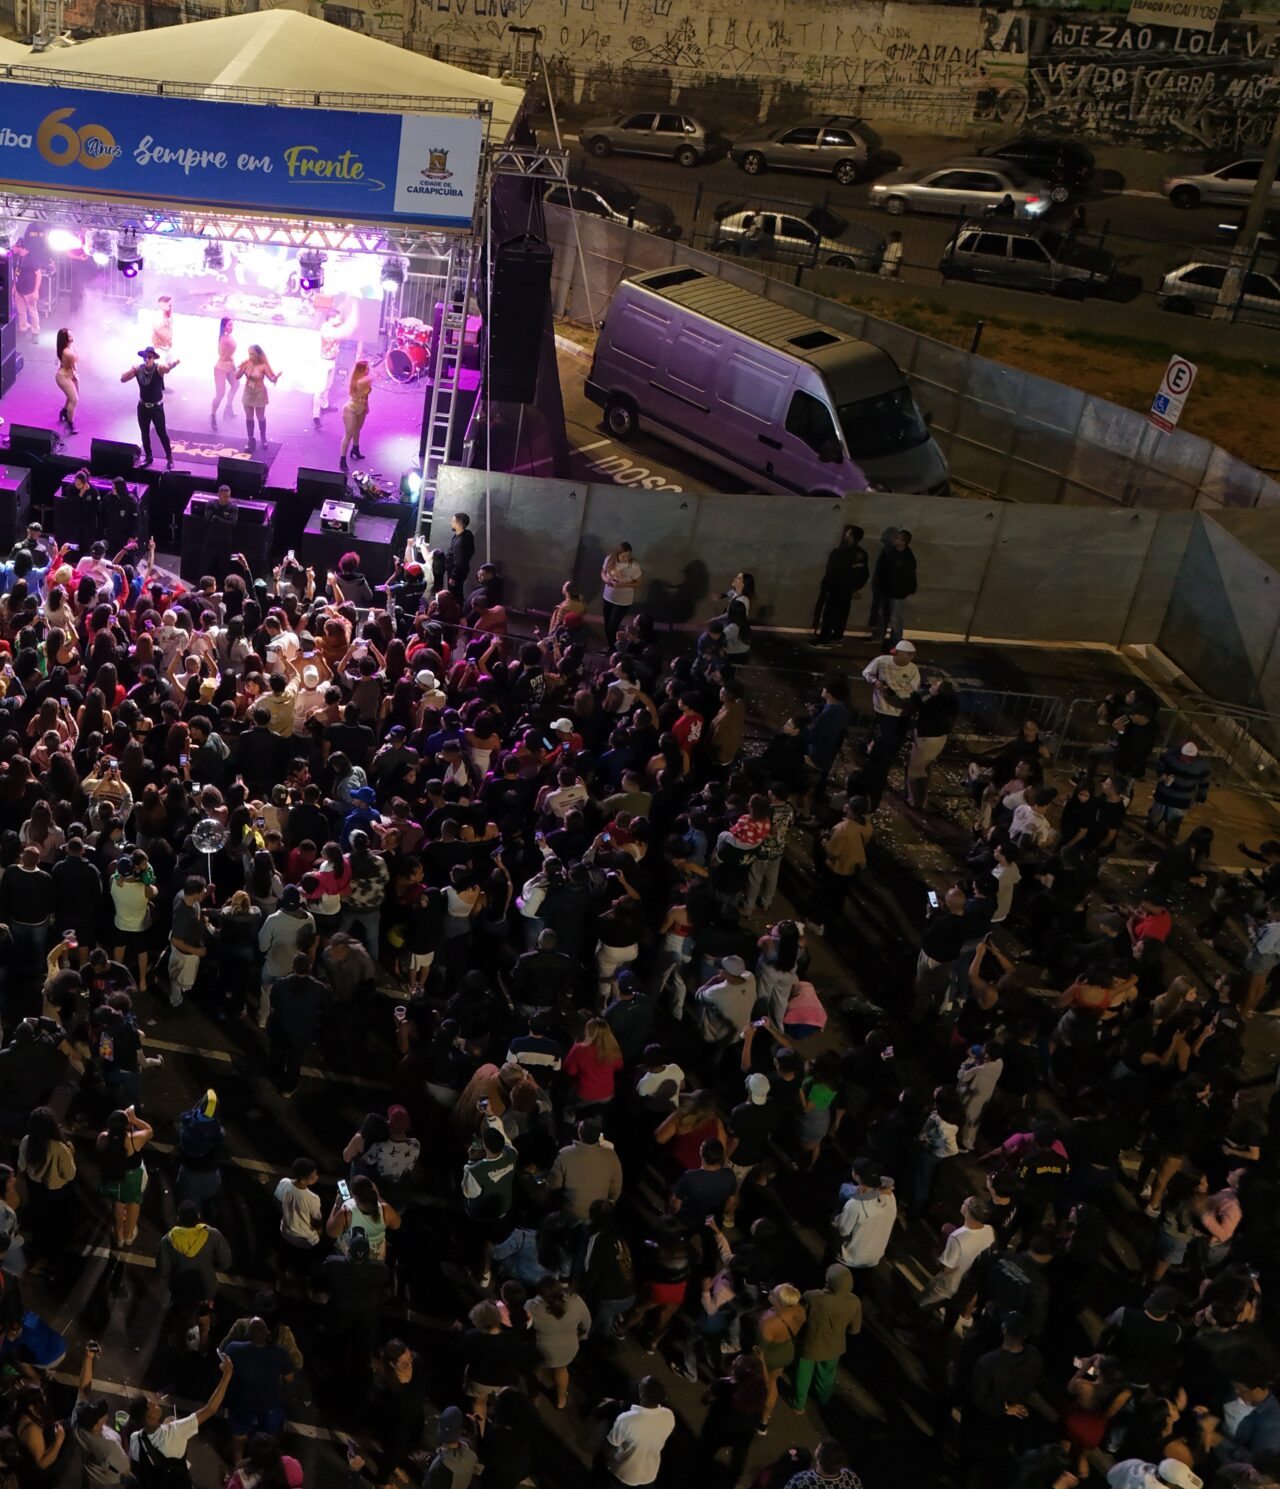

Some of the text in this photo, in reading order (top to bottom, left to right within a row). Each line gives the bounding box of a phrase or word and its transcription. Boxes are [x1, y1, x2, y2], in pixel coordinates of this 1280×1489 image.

[1174, 28, 1229, 55] LOLA
[37, 107, 117, 171] 60
[87, 137, 122, 158] Anos
[133, 135, 365, 180] Sempre em Frente
[420, 180, 442, 188] CIDADE
[1172, 367, 1186, 388] E
